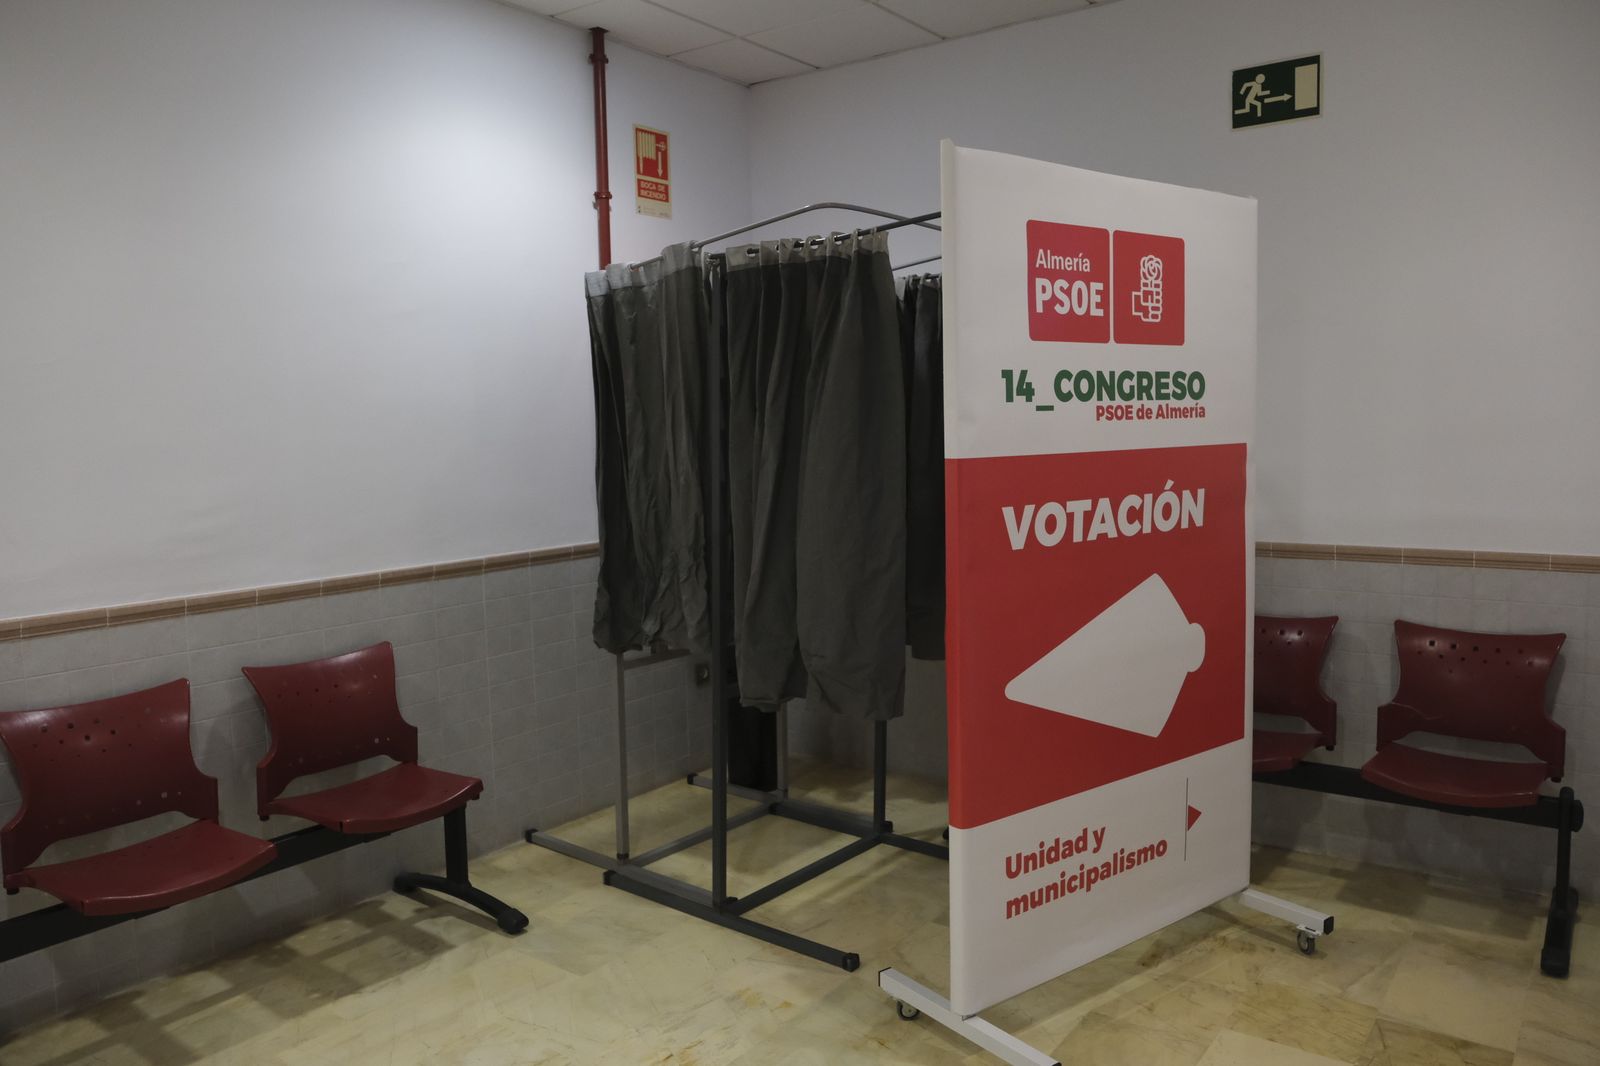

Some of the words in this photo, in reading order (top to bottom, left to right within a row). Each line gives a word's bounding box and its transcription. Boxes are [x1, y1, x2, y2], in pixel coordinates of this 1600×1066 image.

[640, 181, 657, 190] BOCA
[657, 184, 666, 192] DE
[640, 190, 667, 200] INCENDIO
[1035, 248, 1091, 272] Almería
[1035, 277, 1104, 317] PSOE
[1096, 405, 1133, 421] PSOE
[1136, 404, 1153, 420] de
[1155, 403, 1206, 419] Almería
[1001, 479, 1206, 551] VOTACIÓN
[1005, 827, 1088, 880] Unidad
[1092, 826, 1106, 853] y
[1006, 839, 1168, 919] municipalismo
